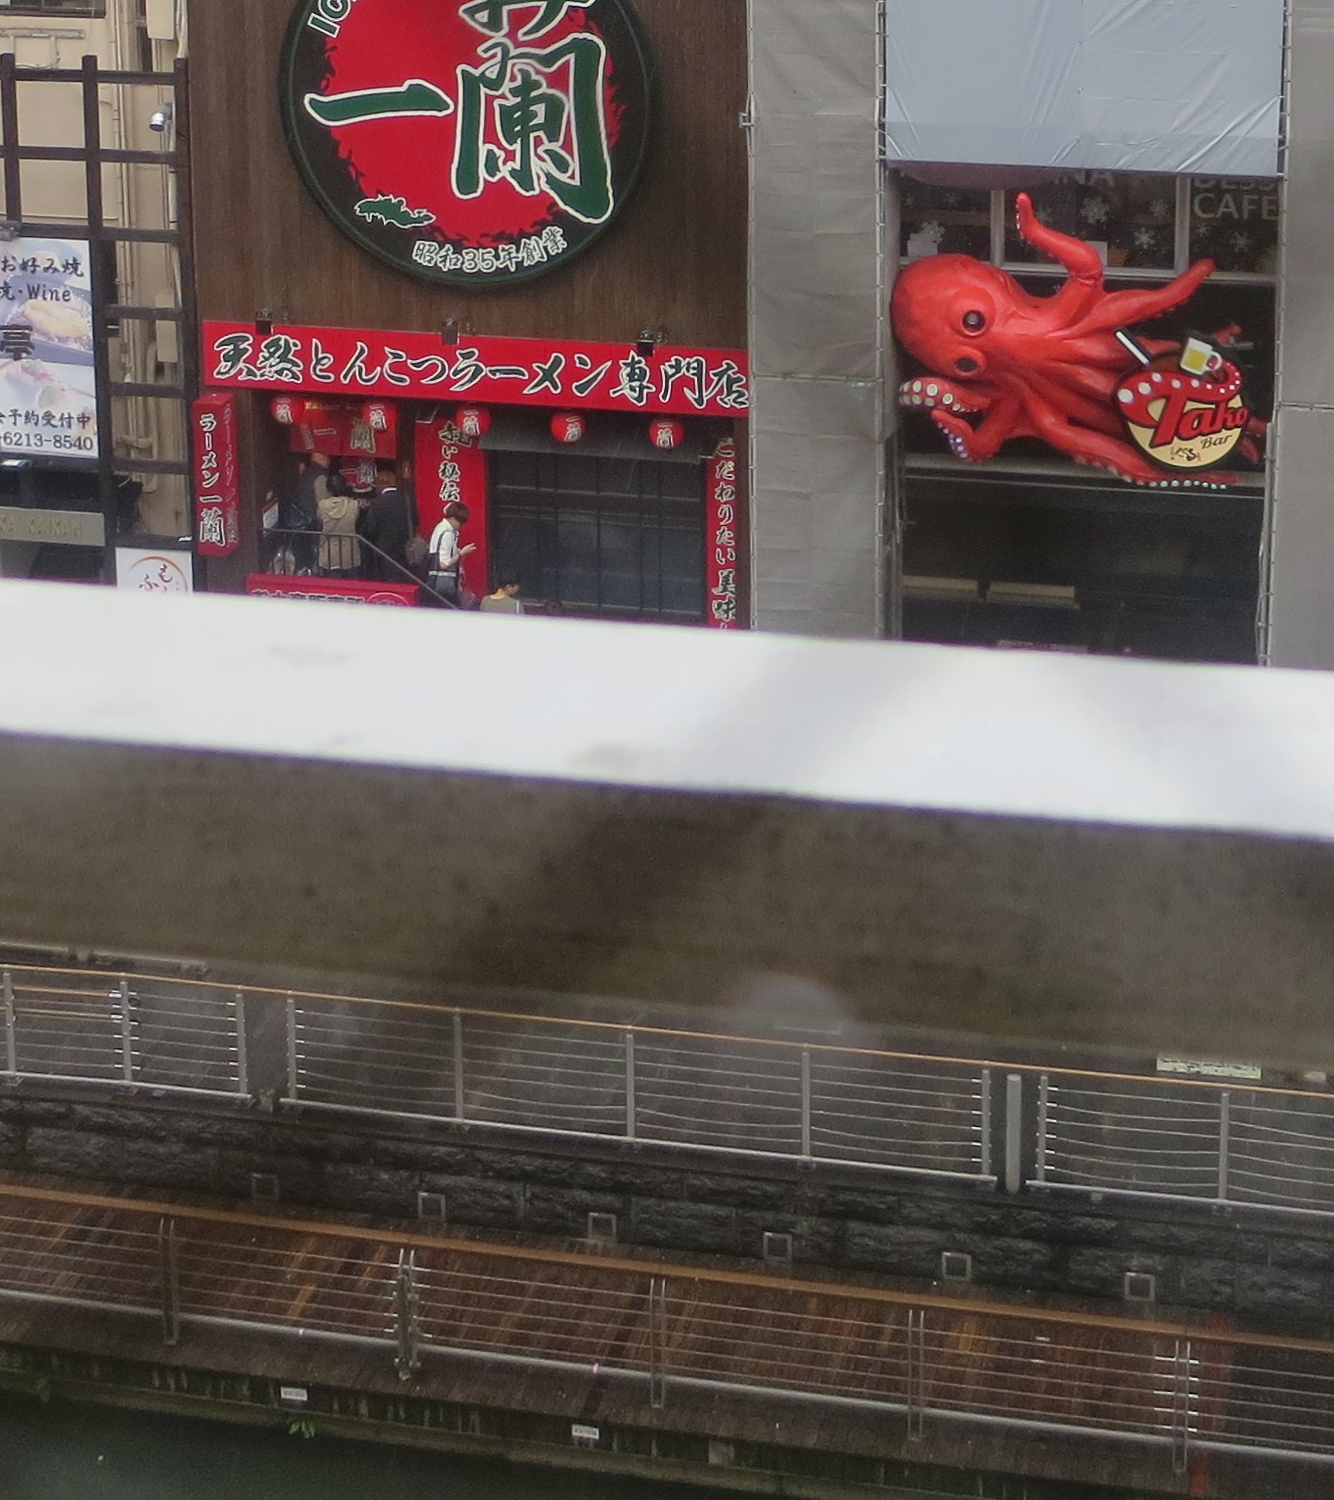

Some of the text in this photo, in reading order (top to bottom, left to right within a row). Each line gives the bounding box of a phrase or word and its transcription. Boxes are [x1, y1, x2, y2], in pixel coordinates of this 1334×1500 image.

[1193, 192, 1278, 220] CAFE
[412, 226, 569, 274] 昭和35年創業
[213, 333, 749, 410] 天然とんこつラーメン専門店
[1130, 384, 1249, 449] Tako
[1200, 433, 1233, 450] Bar
[198, 412, 227, 547] ラーメン一蘭
[438, 420, 473, 515] 赤い秘伝
[711, 437, 737, 628] こだわりたい美味
